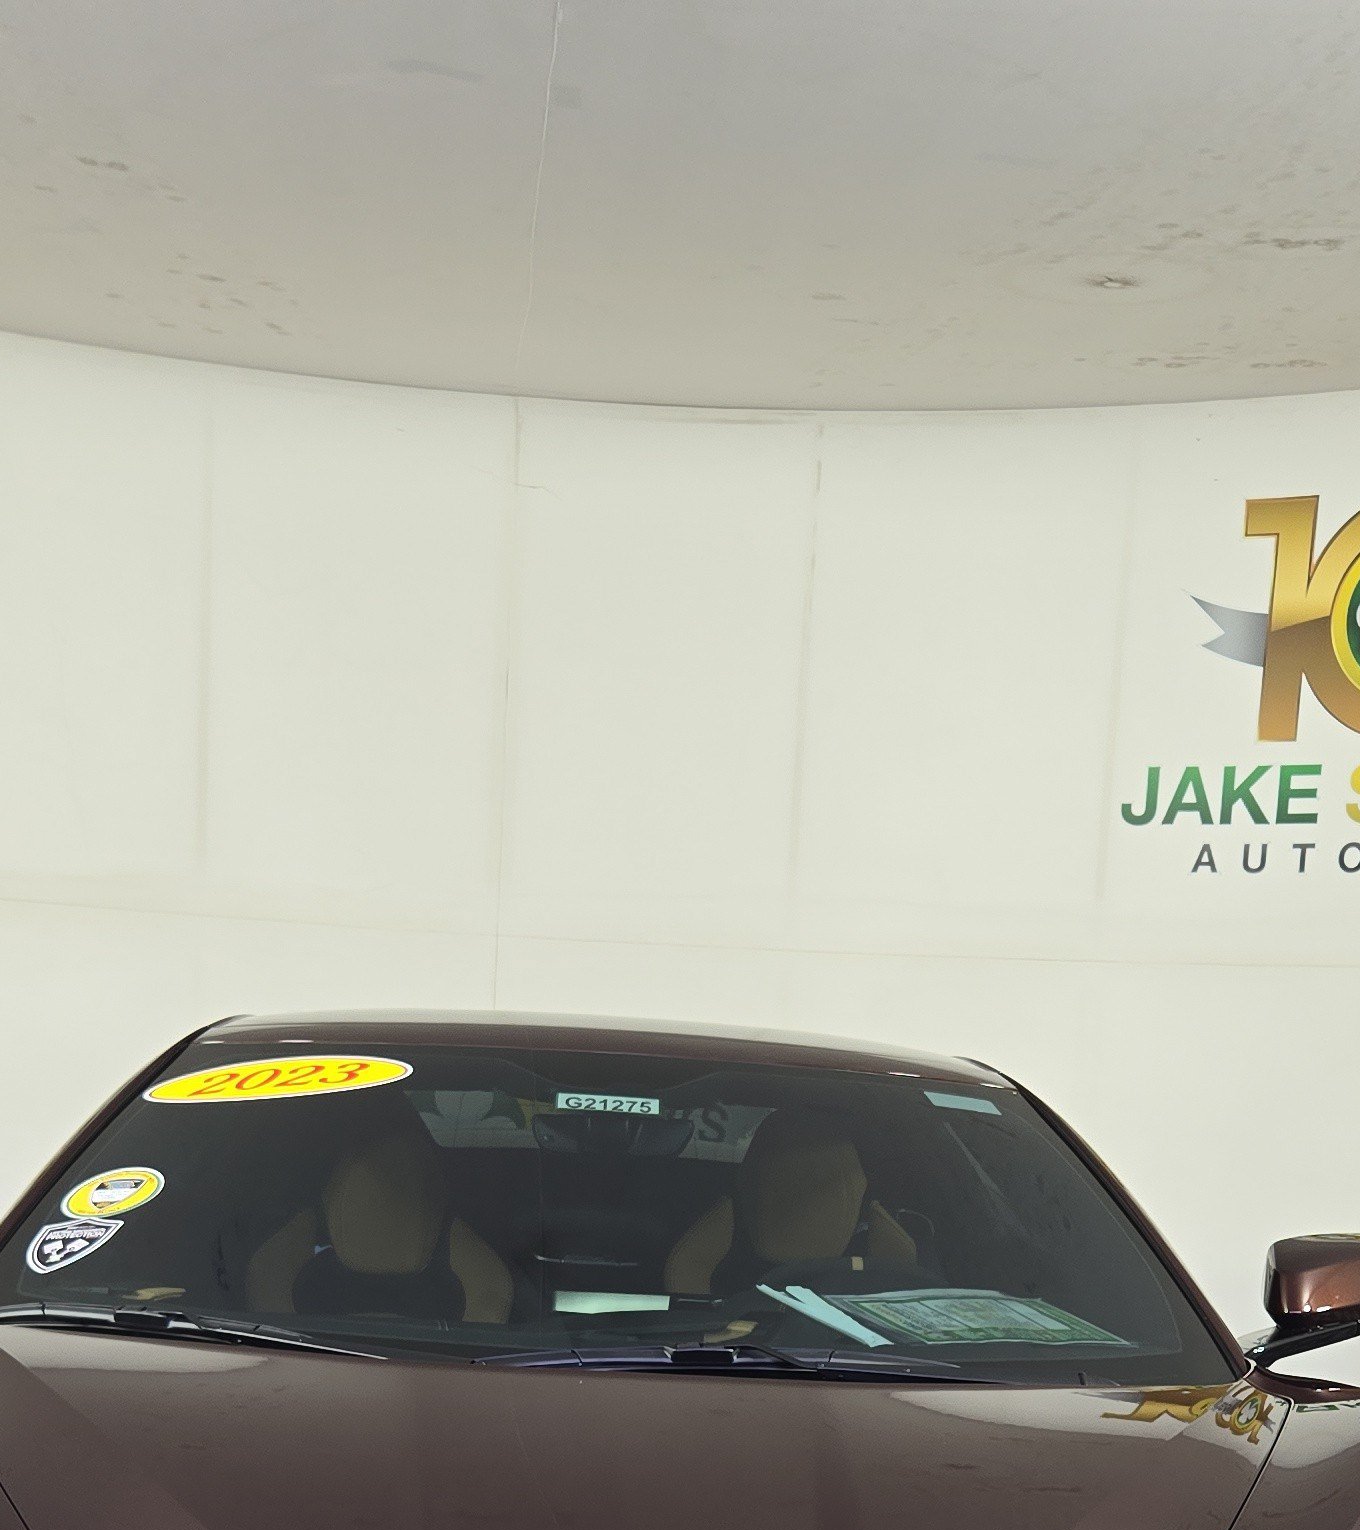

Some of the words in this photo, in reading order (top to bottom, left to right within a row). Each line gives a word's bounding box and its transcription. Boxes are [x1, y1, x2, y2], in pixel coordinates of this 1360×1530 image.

[1121, 763, 1322, 827] JAKE
[187, 1063, 370, 1097] 2023
[565, 1097, 652, 1113] G21275
